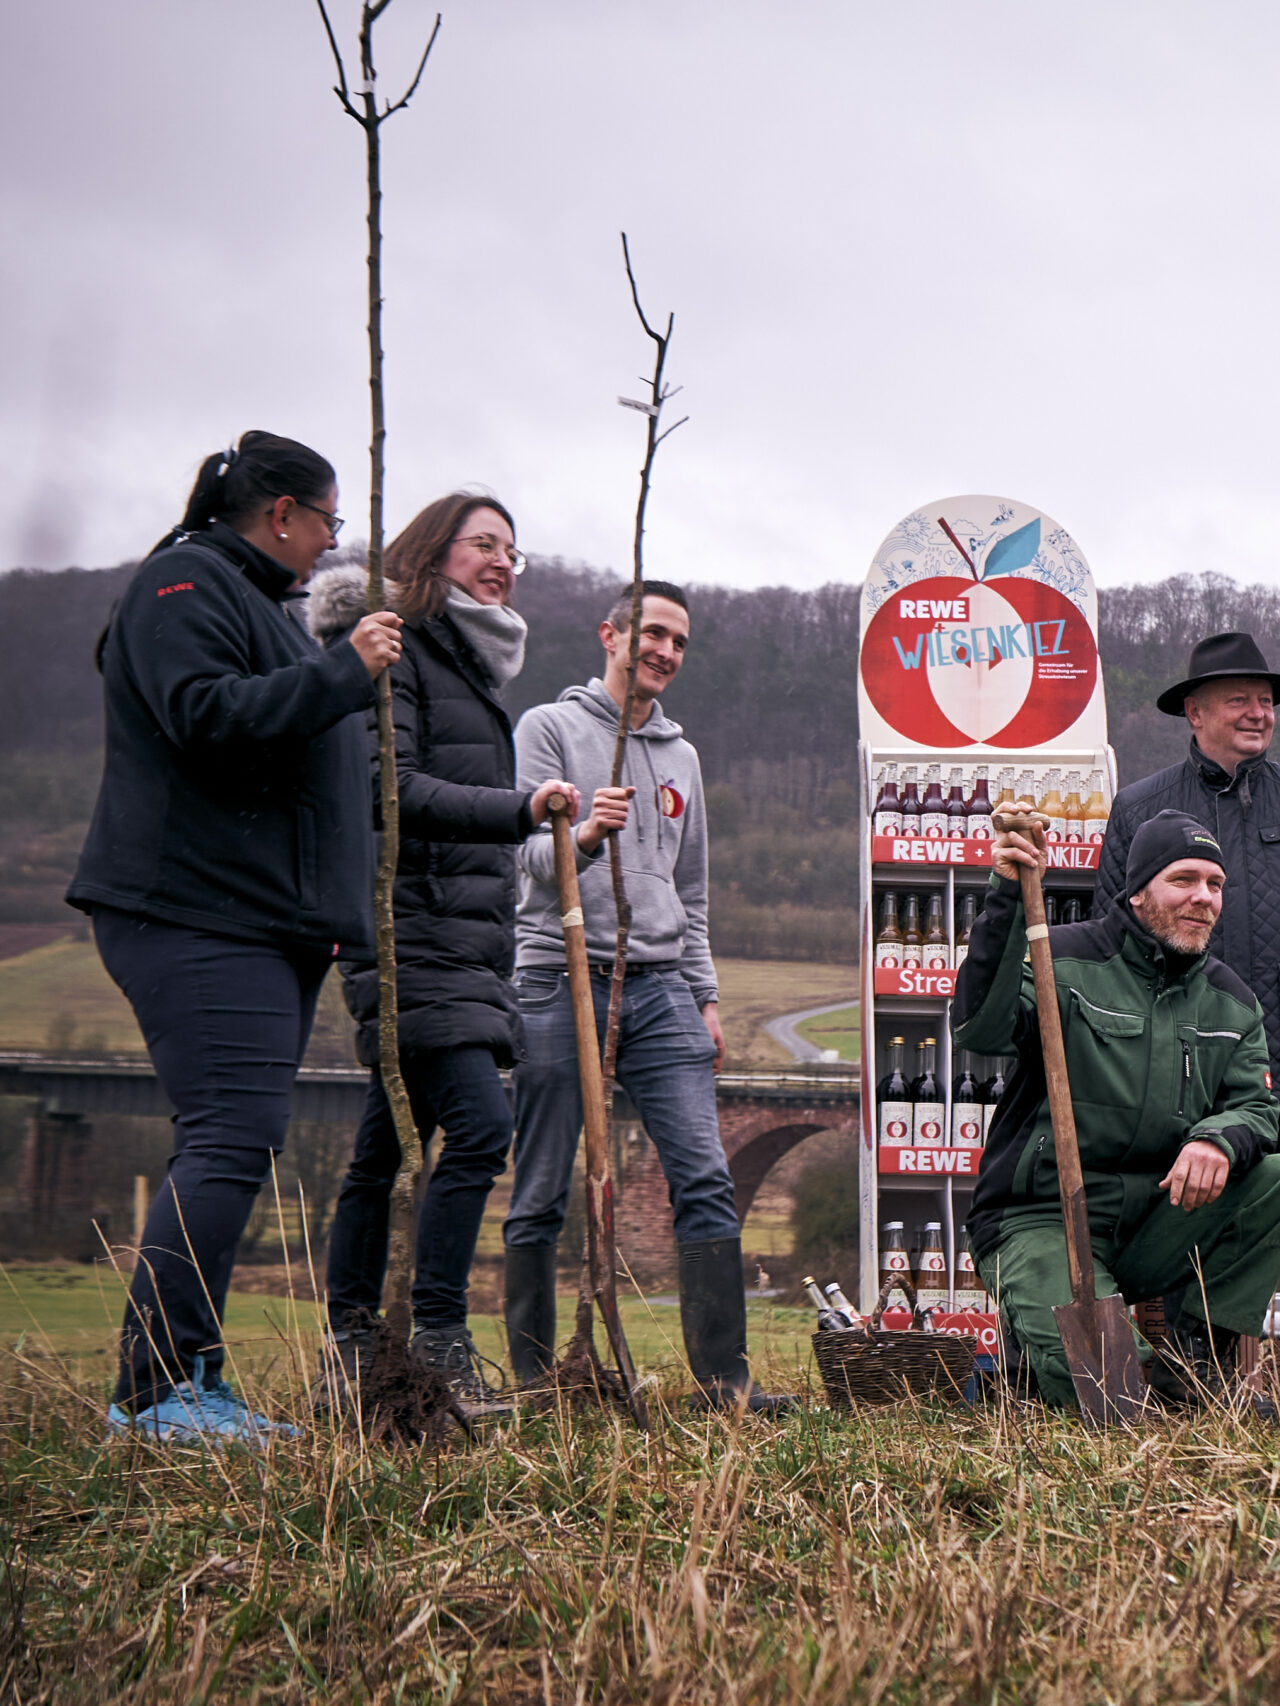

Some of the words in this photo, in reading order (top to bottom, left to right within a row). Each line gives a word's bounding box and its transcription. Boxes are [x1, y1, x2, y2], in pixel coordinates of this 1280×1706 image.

[900, 600, 967, 619] REWE
[892, 619, 1070, 670] WIESENKIEZ
[893, 839, 965, 862] REWE
[1045, 846, 1095, 868] NKIEZ
[898, 969, 957, 994] Stre
[899, 1149, 972, 1172] REWE
